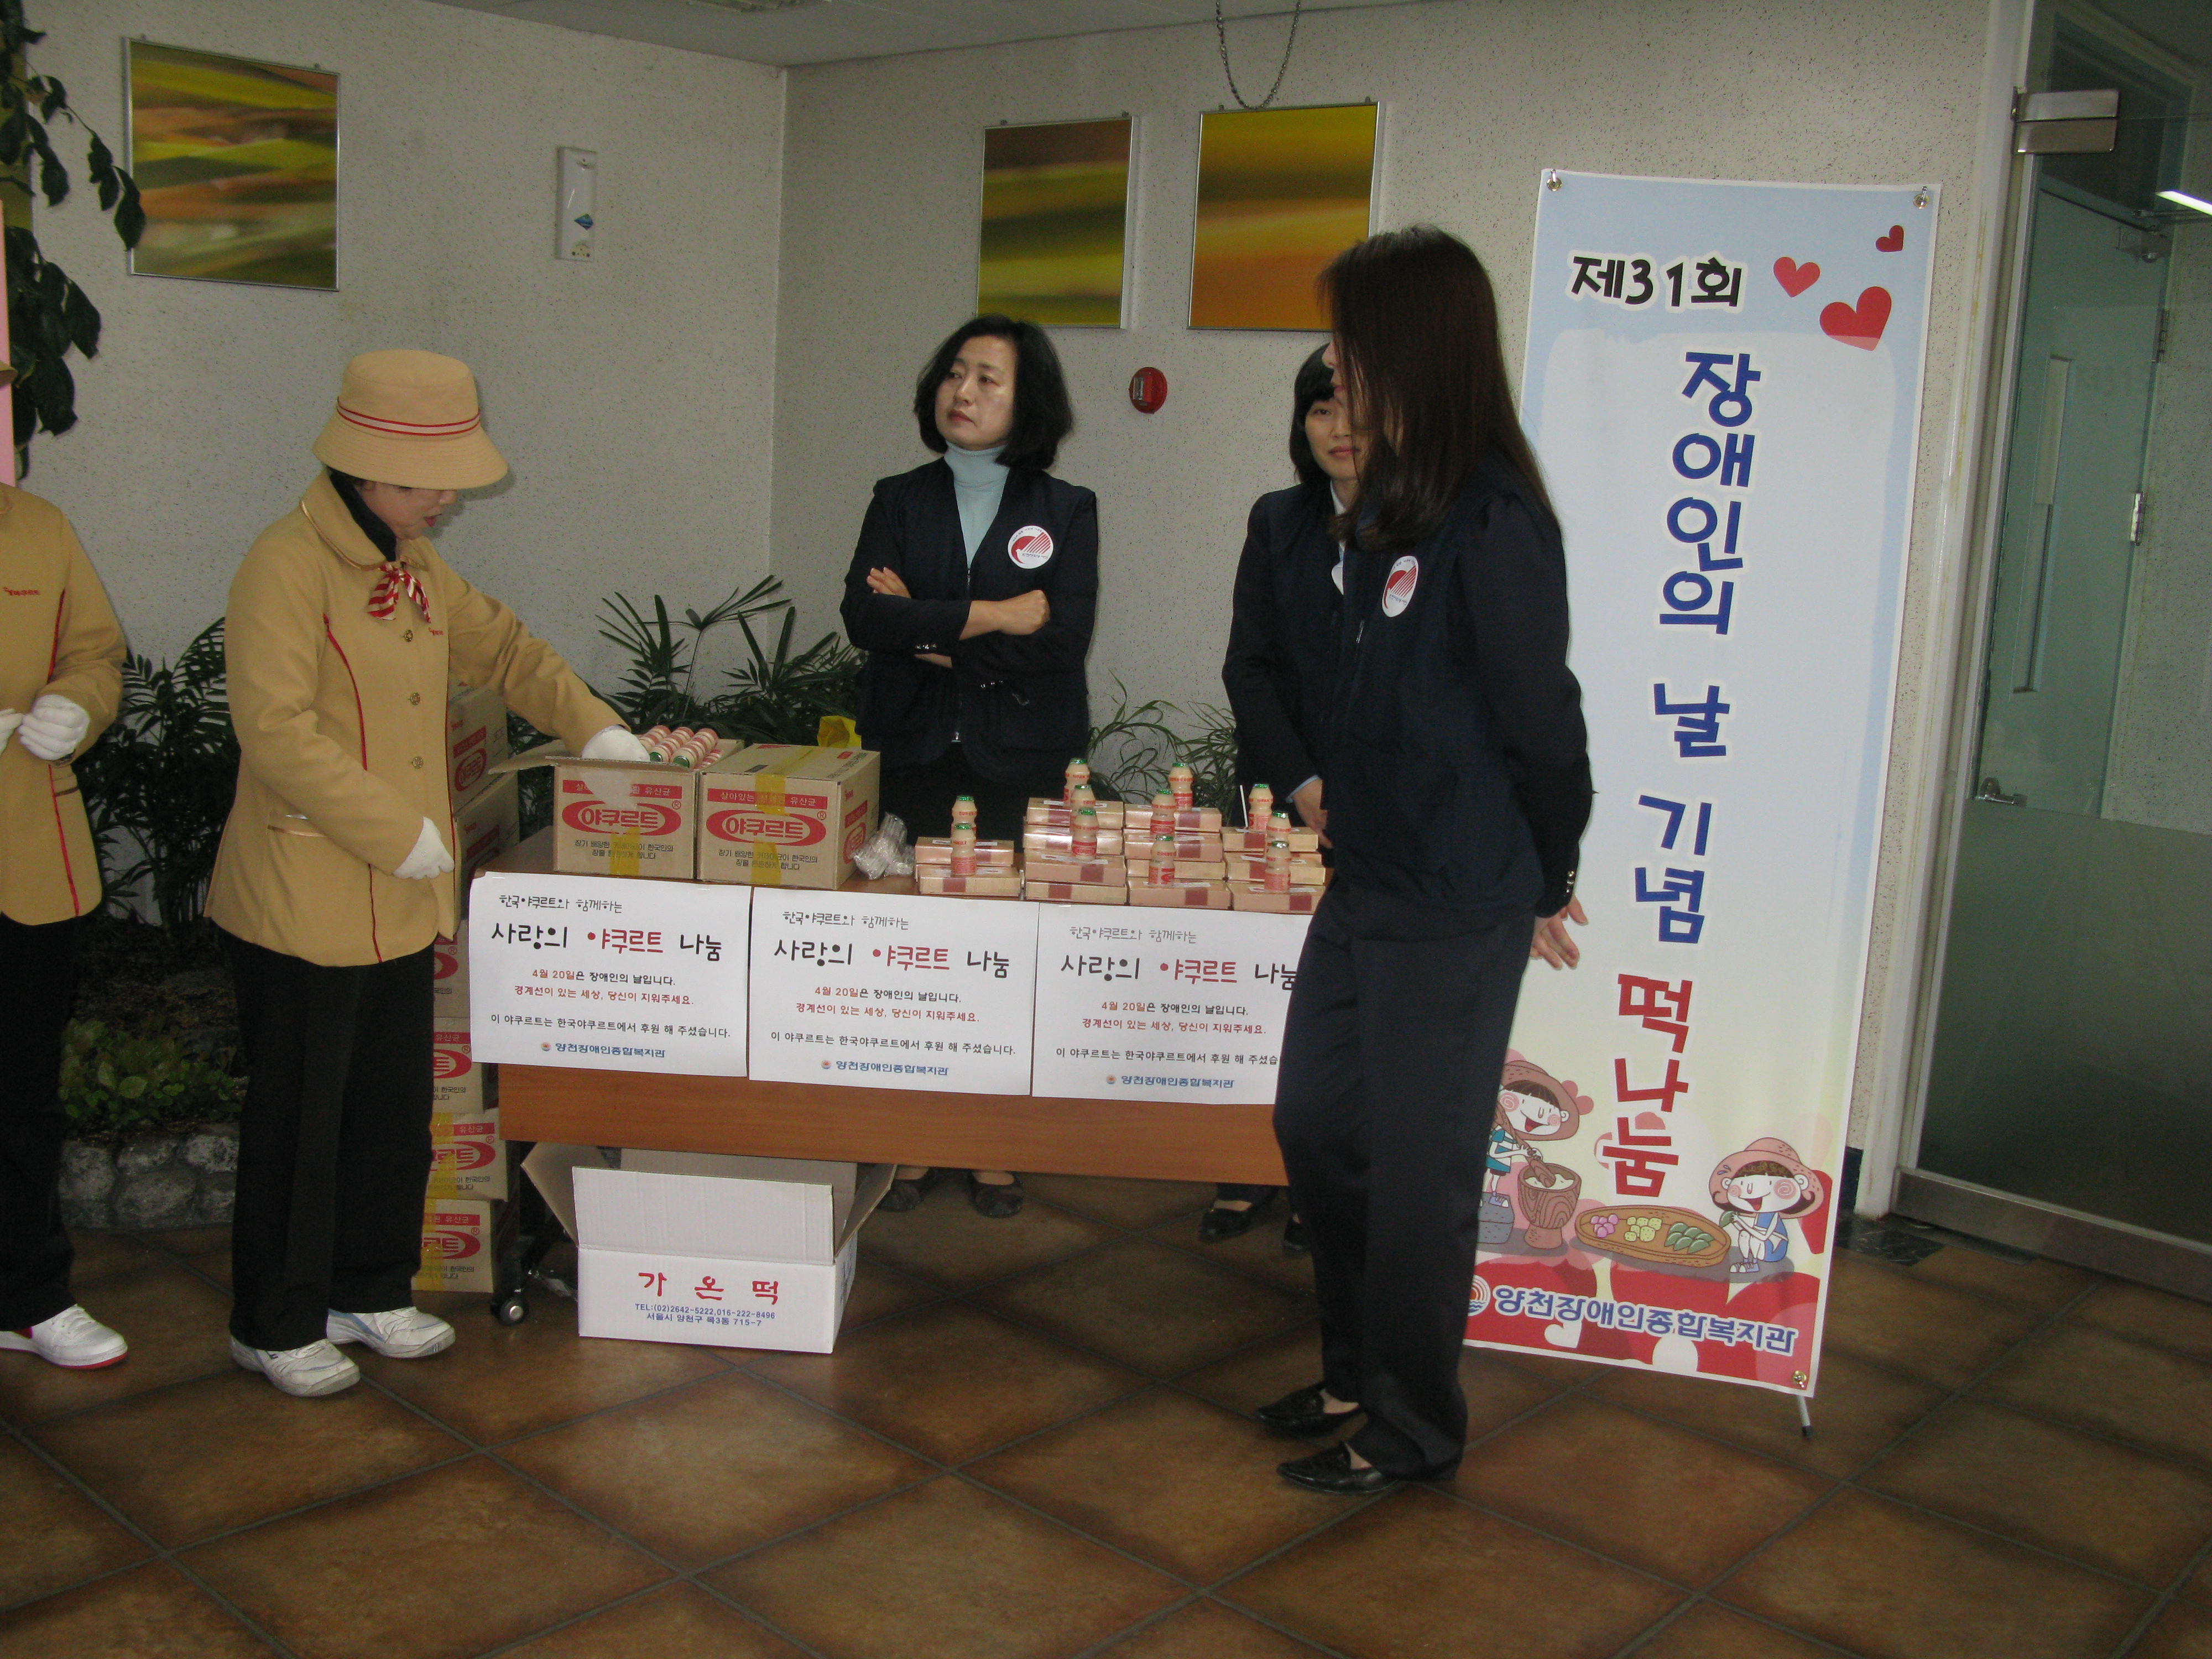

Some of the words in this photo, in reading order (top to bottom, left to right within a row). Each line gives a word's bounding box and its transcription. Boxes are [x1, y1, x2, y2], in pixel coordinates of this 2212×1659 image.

[1570, 256, 1744, 308] 제31회
[1658, 351, 1762, 636] 장애인의
[1653, 682, 1730, 758] 날
[721, 792, 755, 802] 살아있는
[790, 797, 816, 806] 유산균
[581, 808, 658, 828] 야쿠르트
[726, 817, 803, 838] 야쿠르트
[1634, 795, 1713, 945] 기념
[499, 895, 570, 909] 한국야쿠르트와
[576, 900, 623, 914] 함께하는
[782, 911, 855, 926] 한국야쿠르트와
[861, 916, 909, 930] 함께하는
[492, 923, 567, 950] 사랑의
[587, 928, 663, 954] 야쿠르트
[680, 934, 722, 961] 나눔
[1070, 926, 1142, 941] 한국야쿠르트와
[1149, 930, 1197, 944] 함께하는
[774, 940, 852, 967] 사랑의
[873, 945, 950, 971] 야쿠르트
[967, 951, 1010, 978] 나눔
[532, 969, 548, 978] 4월
[552, 971, 585, 980] 20일은
[589, 972, 629, 983] 장애인의
[633, 974, 675, 985] 날입니다.
[1061, 955, 1140, 982] 사랑의
[1160, 959, 1237, 984] 야쿠르트
[1255, 964, 1297, 990] 나눔
[514, 986, 554, 997] 경계선이
[558, 988, 576, 998] 있는
[581, 990, 603, 1000] 세상,
[608, 991, 637, 1002] 당신이
[641, 993, 694, 1005] 지워주세요.
[815, 987, 831, 996] 4월
[836, 988, 869, 998] 20일은
[873, 989, 913, 1001] 장애인의
[918, 992, 961, 1003] 날입니다.
[796, 1003, 836, 1014] 경계선이
[841, 1005, 859, 1016] 있는
[864, 1007, 886, 1018] 세상,
[891, 1009, 921, 1020] 당신이
[926, 1010, 979, 1022] 지워주세요.
[1102, 1002, 1118, 1011] 4월
[1123, 1003, 1155, 1013] 20일은
[1161, 1004, 1201, 1015] 장애인의
[1205, 1006, 1248, 1016] 날입니다.
[491, 1014, 500, 1024] 이
[504, 1015, 552, 1027] 야쿠르트는
[557, 1018, 636, 1032] 한국야쿠르트에서
[640, 1022, 660, 1034] 후원
[664, 1024, 674, 1035] 해
[678, 1025, 731, 1038] 주셨습니다.
[1082, 1019, 1123, 1029] 경계선이
[1127, 1021, 1146, 1030] 있는
[1151, 1022, 1173, 1032] 세상,
[1178, 1023, 1208, 1033] 당신이
[1213, 1024, 1266, 1035] 지워주세요.
[555, 1042, 665, 1058] 양천장애인종합복지관
[771, 1032, 780, 1042] 이
[785, 1032, 834, 1045] 야쿠르트는
[839, 1036, 920, 1050] 한국야쿠르트에서
[924, 1040, 943, 1052] 후원
[948, 1042, 958, 1052] 해
[962, 1044, 1016, 1056] 주셨습니다.
[1056, 1048, 1065, 1058] 이
[1070, 1049, 1120, 1060] 야쿠르트는
[1125, 1051, 1206, 1063] 한국야쿠르트에서
[1211, 1054, 1230, 1064] 후원
[1234, 1055, 1244, 1064] 해
[1248, 1056, 1280, 1065] 주셨습
[836, 1061, 949, 1076] 양천장애인종합복지관
[1121, 1076, 1234, 1089] 양천장애인종합복지관
[1601, 973, 1690, 1198] 떡나눔
[638, 1272, 667, 1297] 가
[694, 1276, 724, 1301] 온
[752, 1280, 779, 1305] 떡
[646, 1312, 673, 1322] 서울시
[676, 1314, 703, 1324] 양천구
[707, 1316, 729, 1326] 목3동
[733, 1318, 762, 1326] 715-7
[1494, 1287, 1795, 1353] 양천장애인종합복지관
